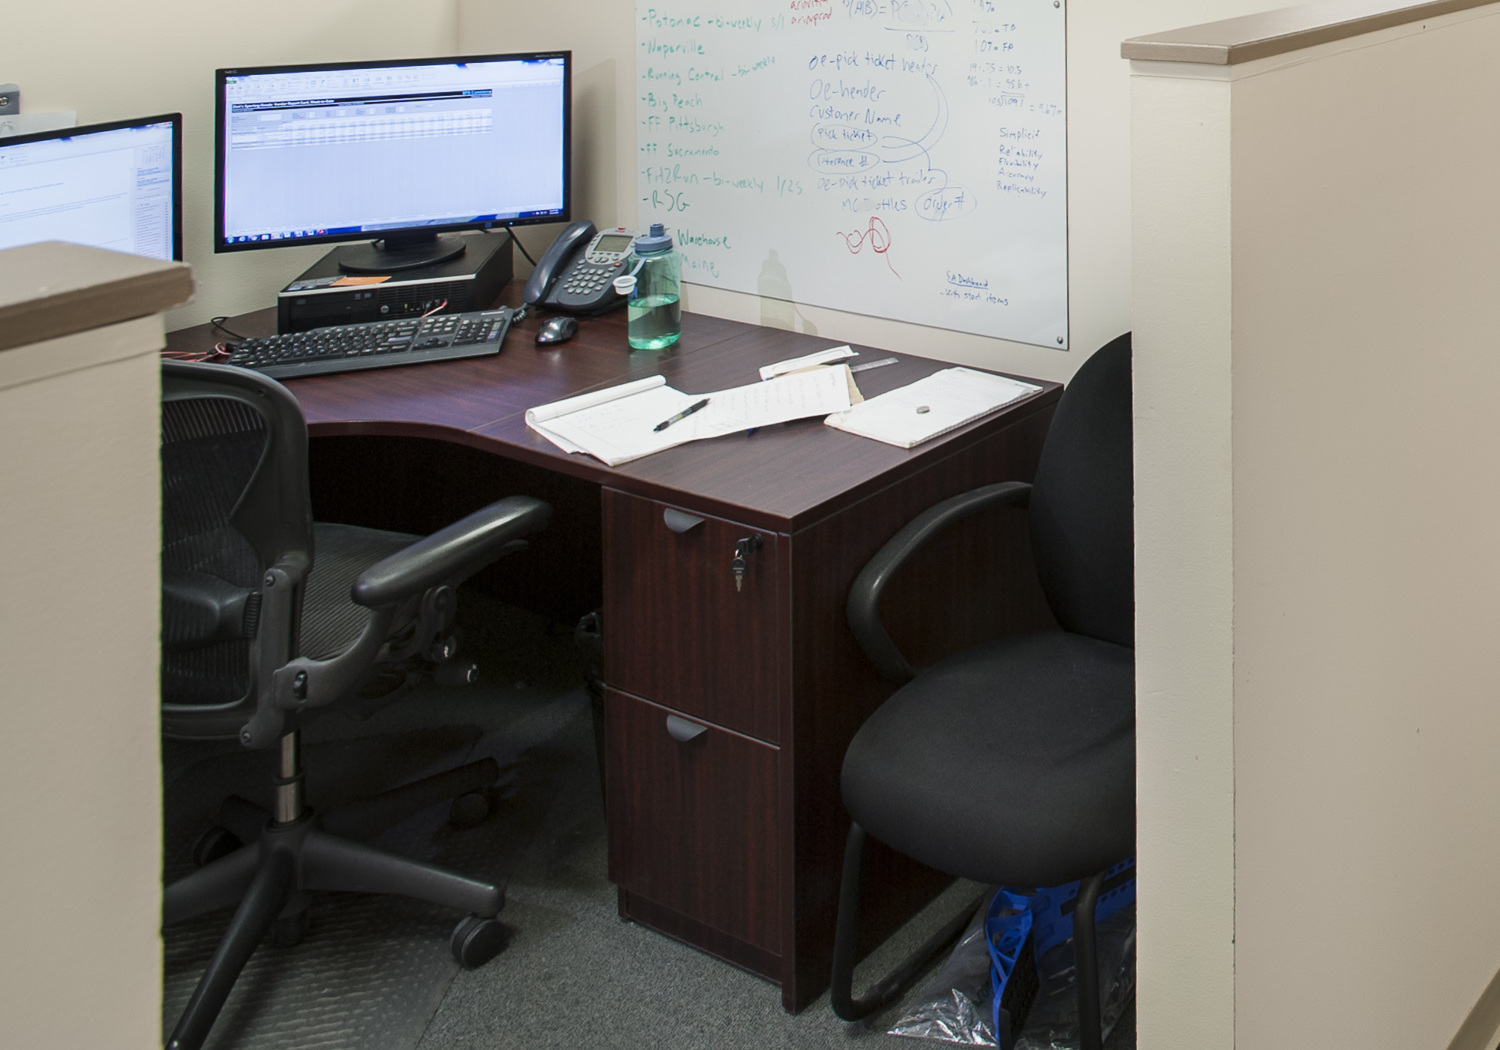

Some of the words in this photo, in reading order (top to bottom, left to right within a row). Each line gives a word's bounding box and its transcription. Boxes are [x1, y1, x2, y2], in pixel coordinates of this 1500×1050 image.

[809, 104, 860, 120] Customer
[865, 108, 902, 127] Name
[667, 143, 720, 158] Sacramento
